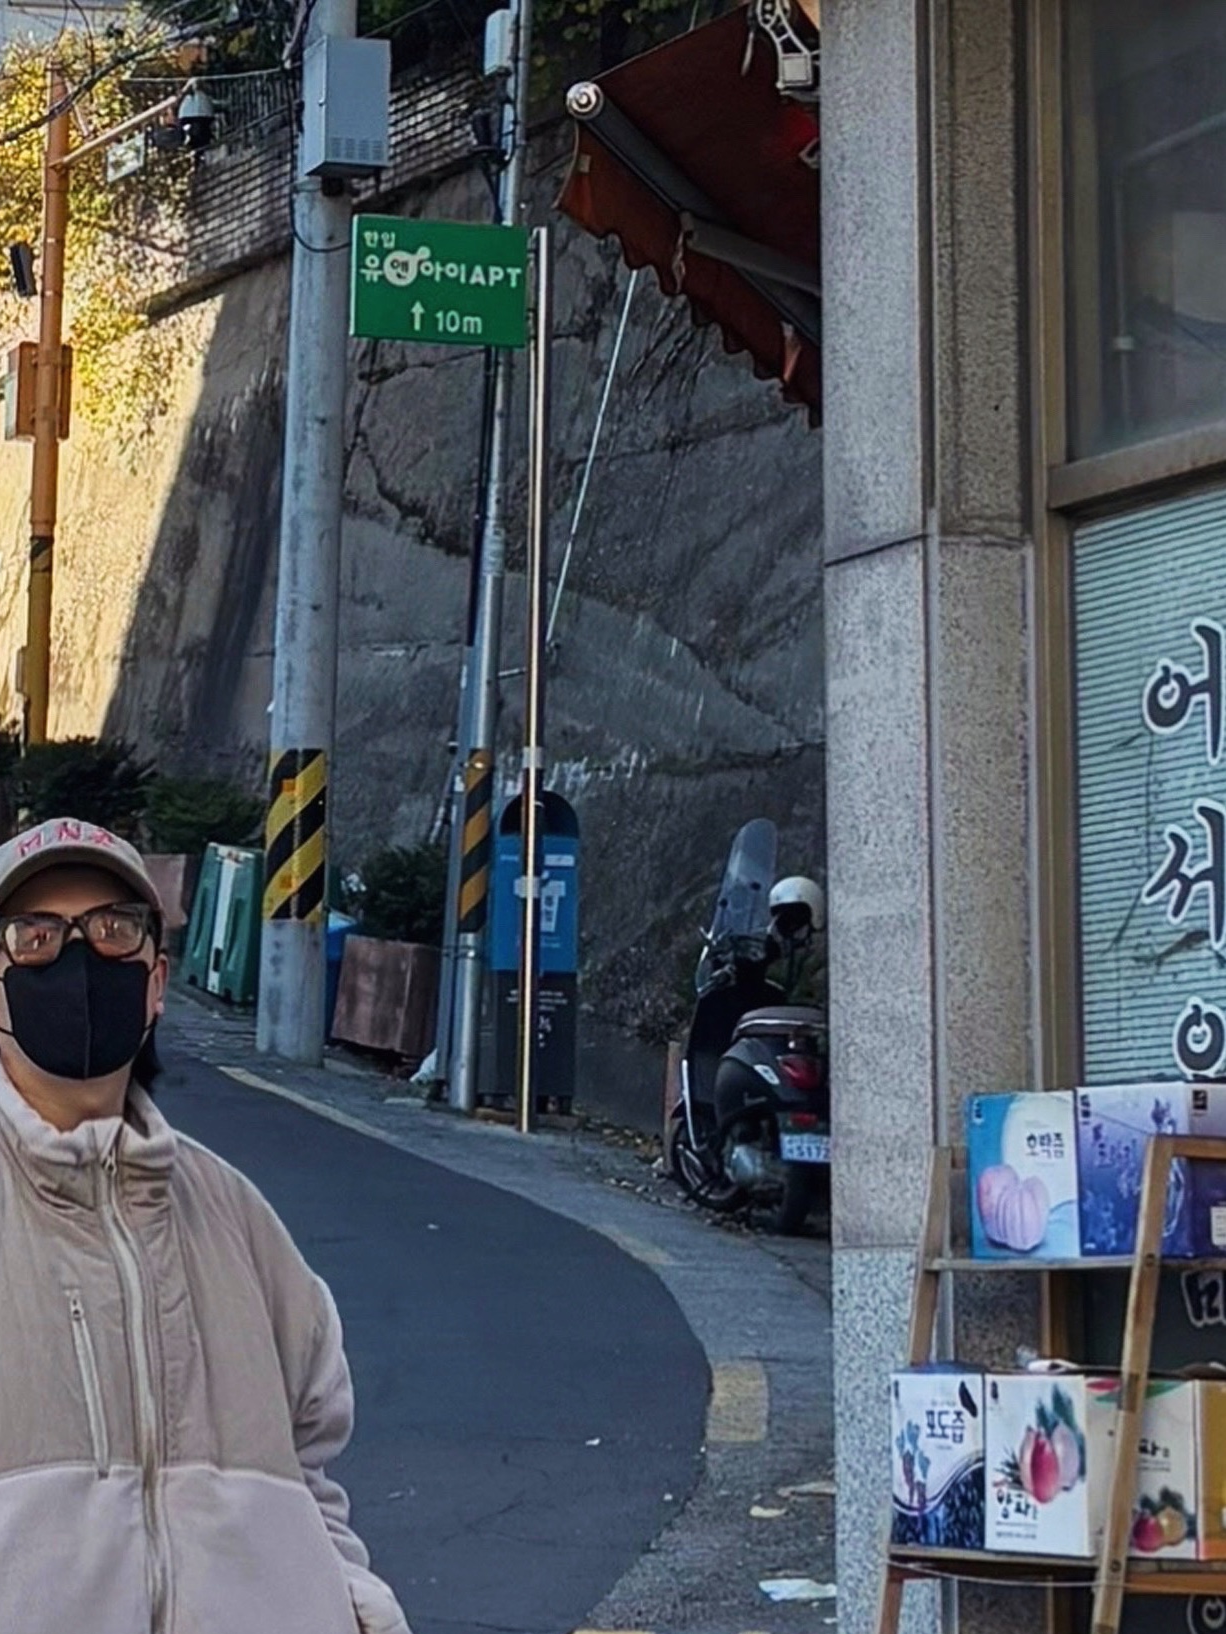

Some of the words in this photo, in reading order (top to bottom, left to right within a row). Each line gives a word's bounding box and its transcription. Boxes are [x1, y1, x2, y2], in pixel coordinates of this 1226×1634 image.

[435, 311, 482, 334] 10m
[1025, 1132, 1065, 1159] 호박즙
[925, 1409, 966, 1444] 포도즙
